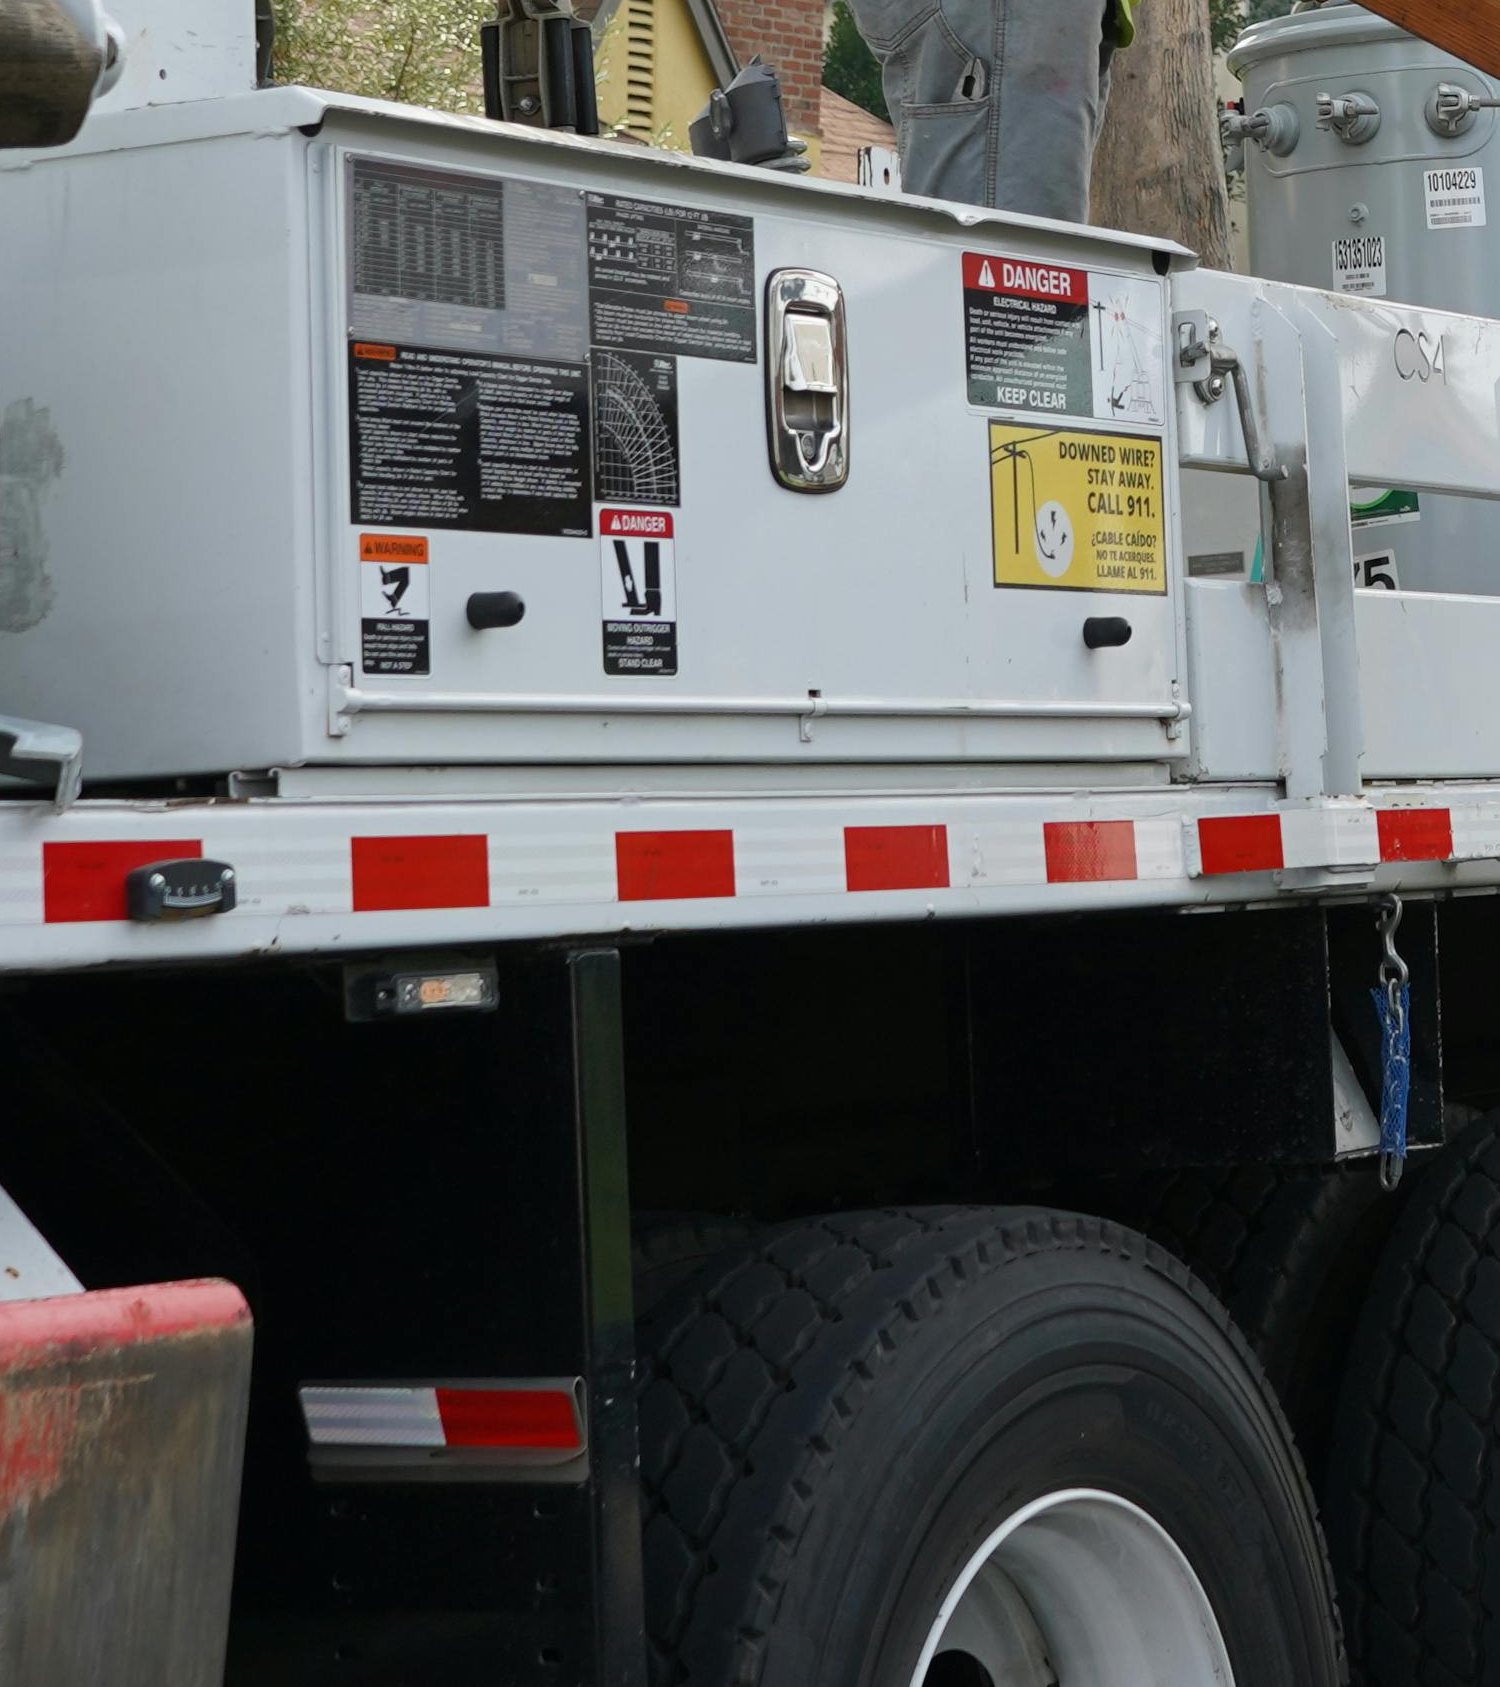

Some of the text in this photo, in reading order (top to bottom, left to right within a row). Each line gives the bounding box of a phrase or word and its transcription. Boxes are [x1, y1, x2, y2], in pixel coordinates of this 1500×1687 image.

[1428, 170, 1476, 192] 10104229
[1334, 237, 1382, 270] 1531351023
[1002, 263, 1071, 296] DANGER
[993, 296, 1057, 314] ELECTRICAL HAZARD
[1394, 328, 1447, 386] CS4
[997, 386, 1066, 409] KEEP CLEAR
[1059, 441, 1155, 468] DOWNED WIRE?
[1088, 468, 1154, 490] STAY AWAY.
[1088, 492, 1155, 518] CALL 911.
[621, 515, 666, 532] DANGER
[1091, 531, 1156, 548] ¿CABLE CAÍDO?
[375, 542, 424, 556] WARNING
[1097, 550, 1155, 564] NO TE ACERQUES.
[1097, 565, 1157, 581] LLAME AL 911.
[1355, 556, 1395, 590] 5
[607, 623, 670, 633] MOVING OUTRIGGER
[627, 636, 654, 646] HAZARD
[398, 662, 412, 670] STEP
[618, 658, 663, 668] STAND CLEAR
